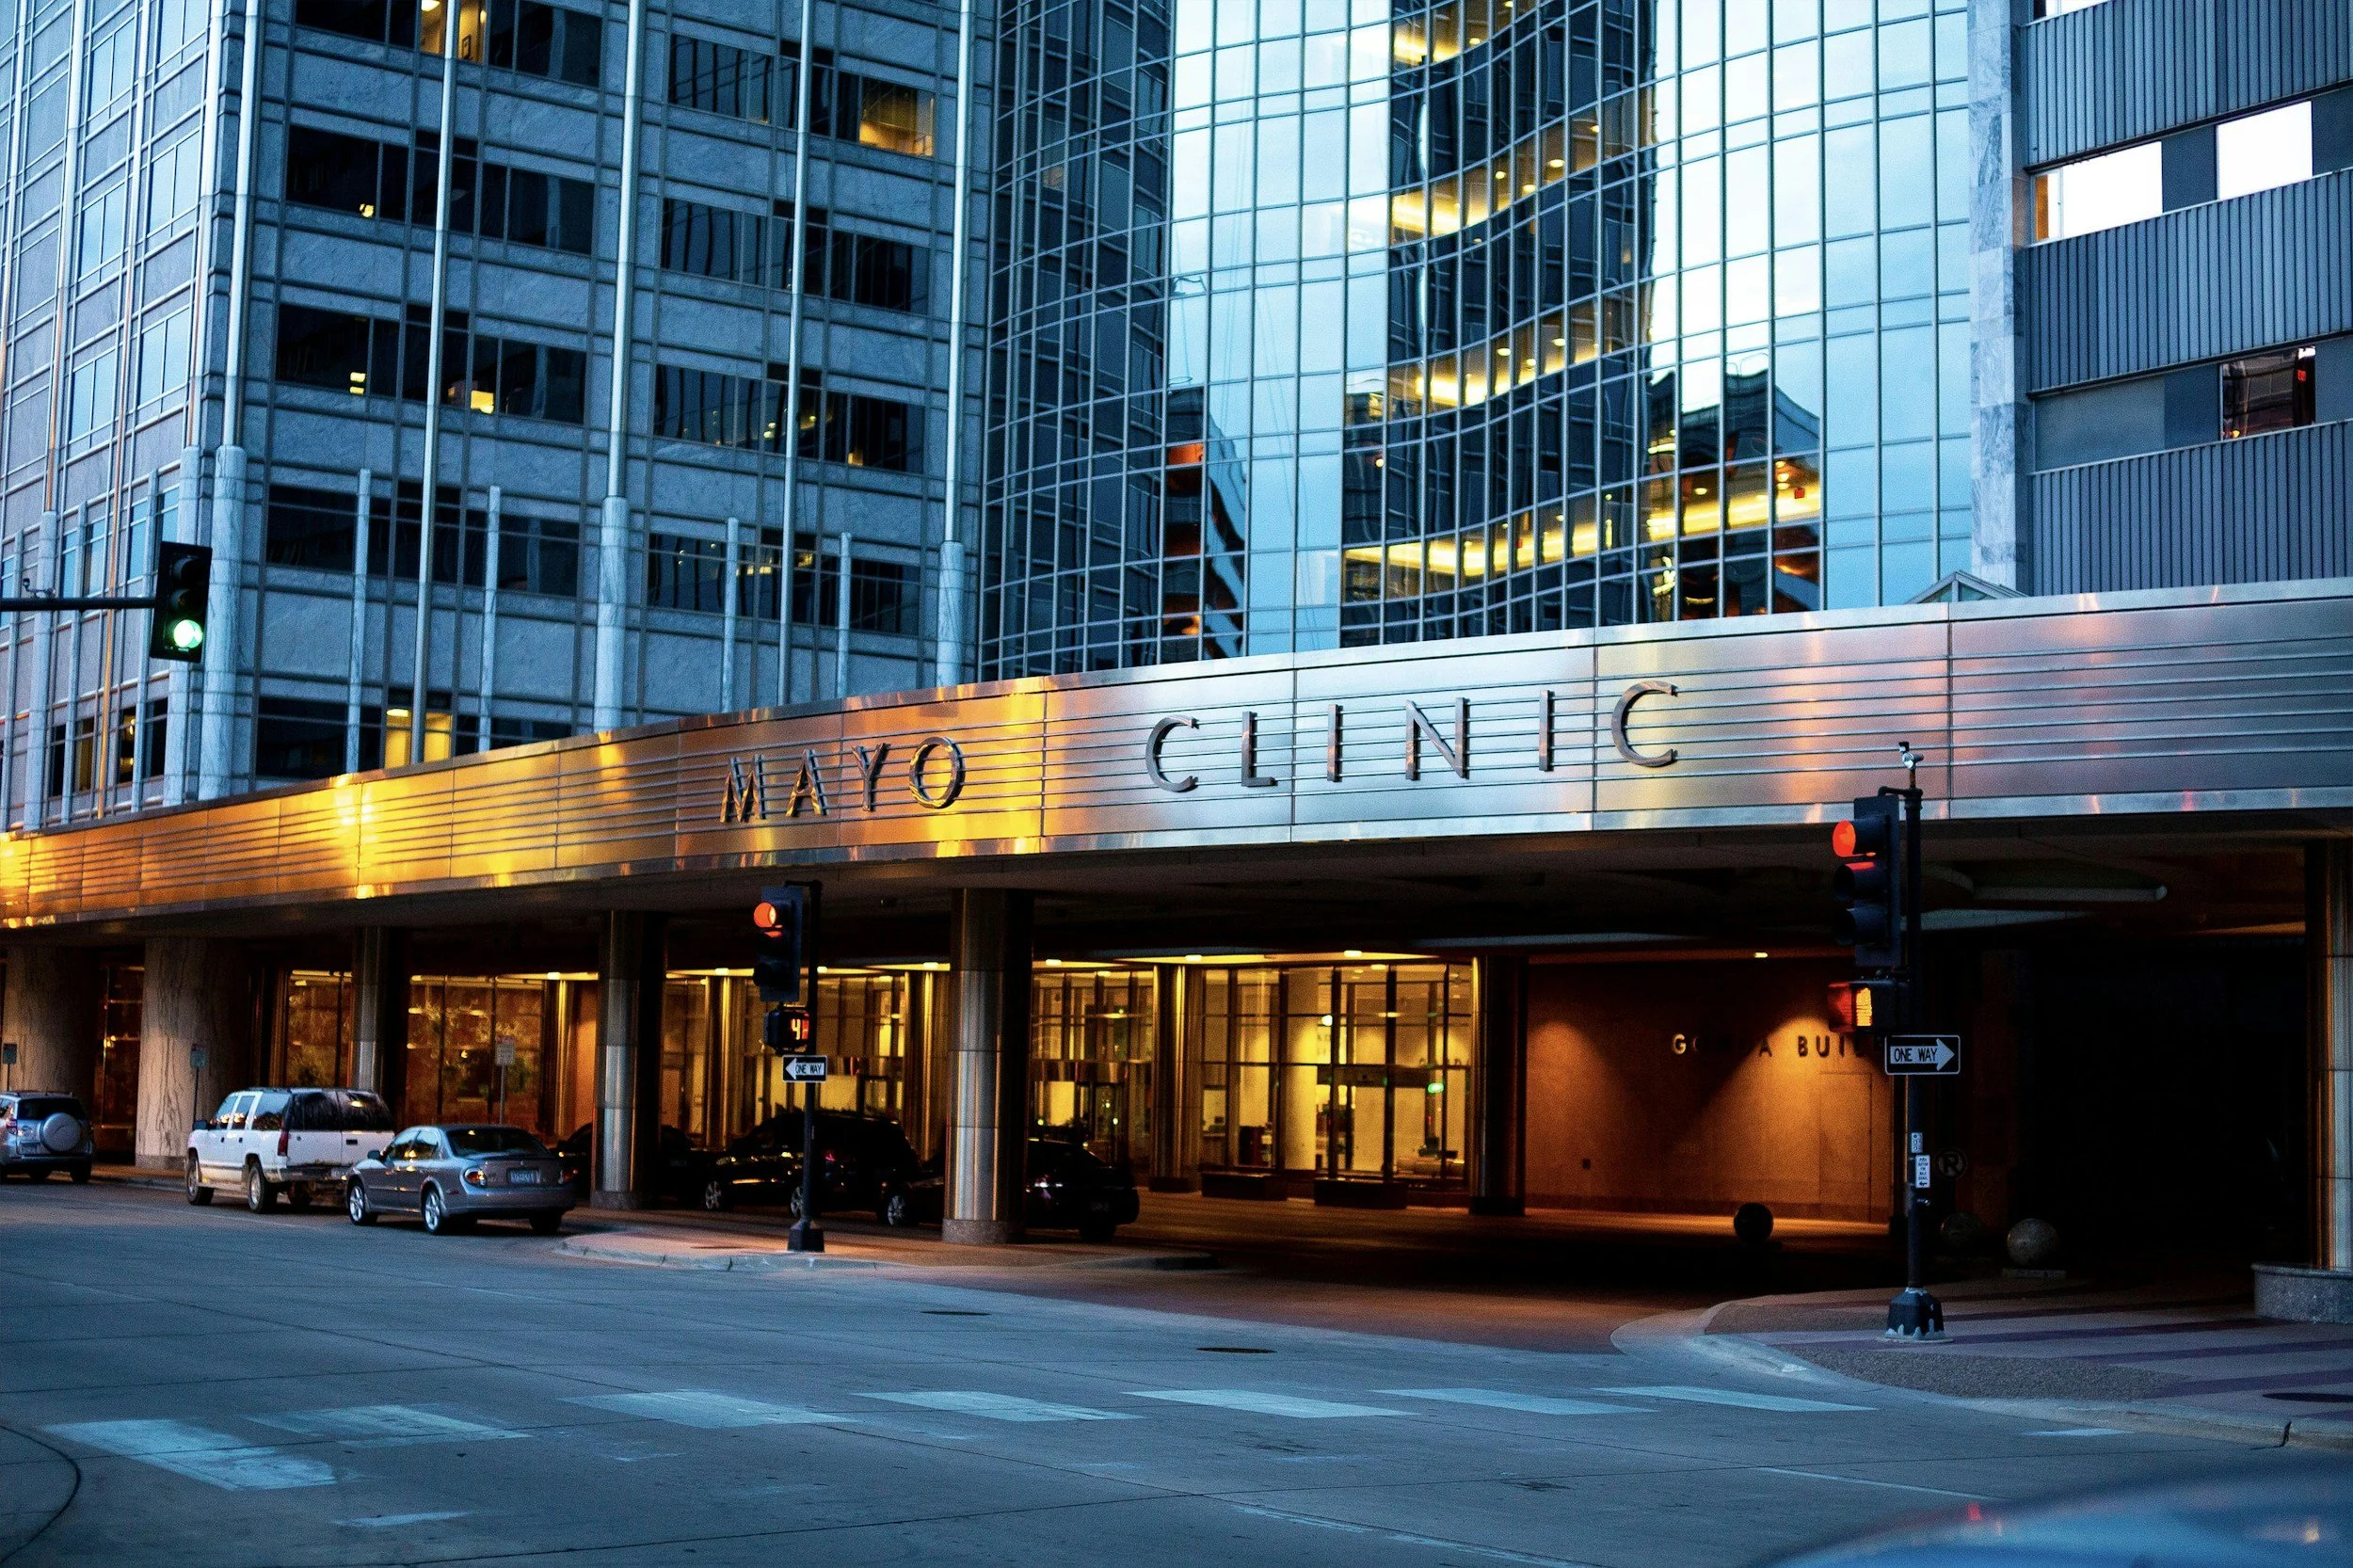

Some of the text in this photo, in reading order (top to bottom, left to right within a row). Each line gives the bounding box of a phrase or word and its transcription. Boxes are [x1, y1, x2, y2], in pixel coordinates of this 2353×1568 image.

[720, 680, 1678, 823] MAYO CLINIC
[1894, 1048, 1938, 1062] ONE WAY
[795, 1064, 822, 1074] ONE WAY
